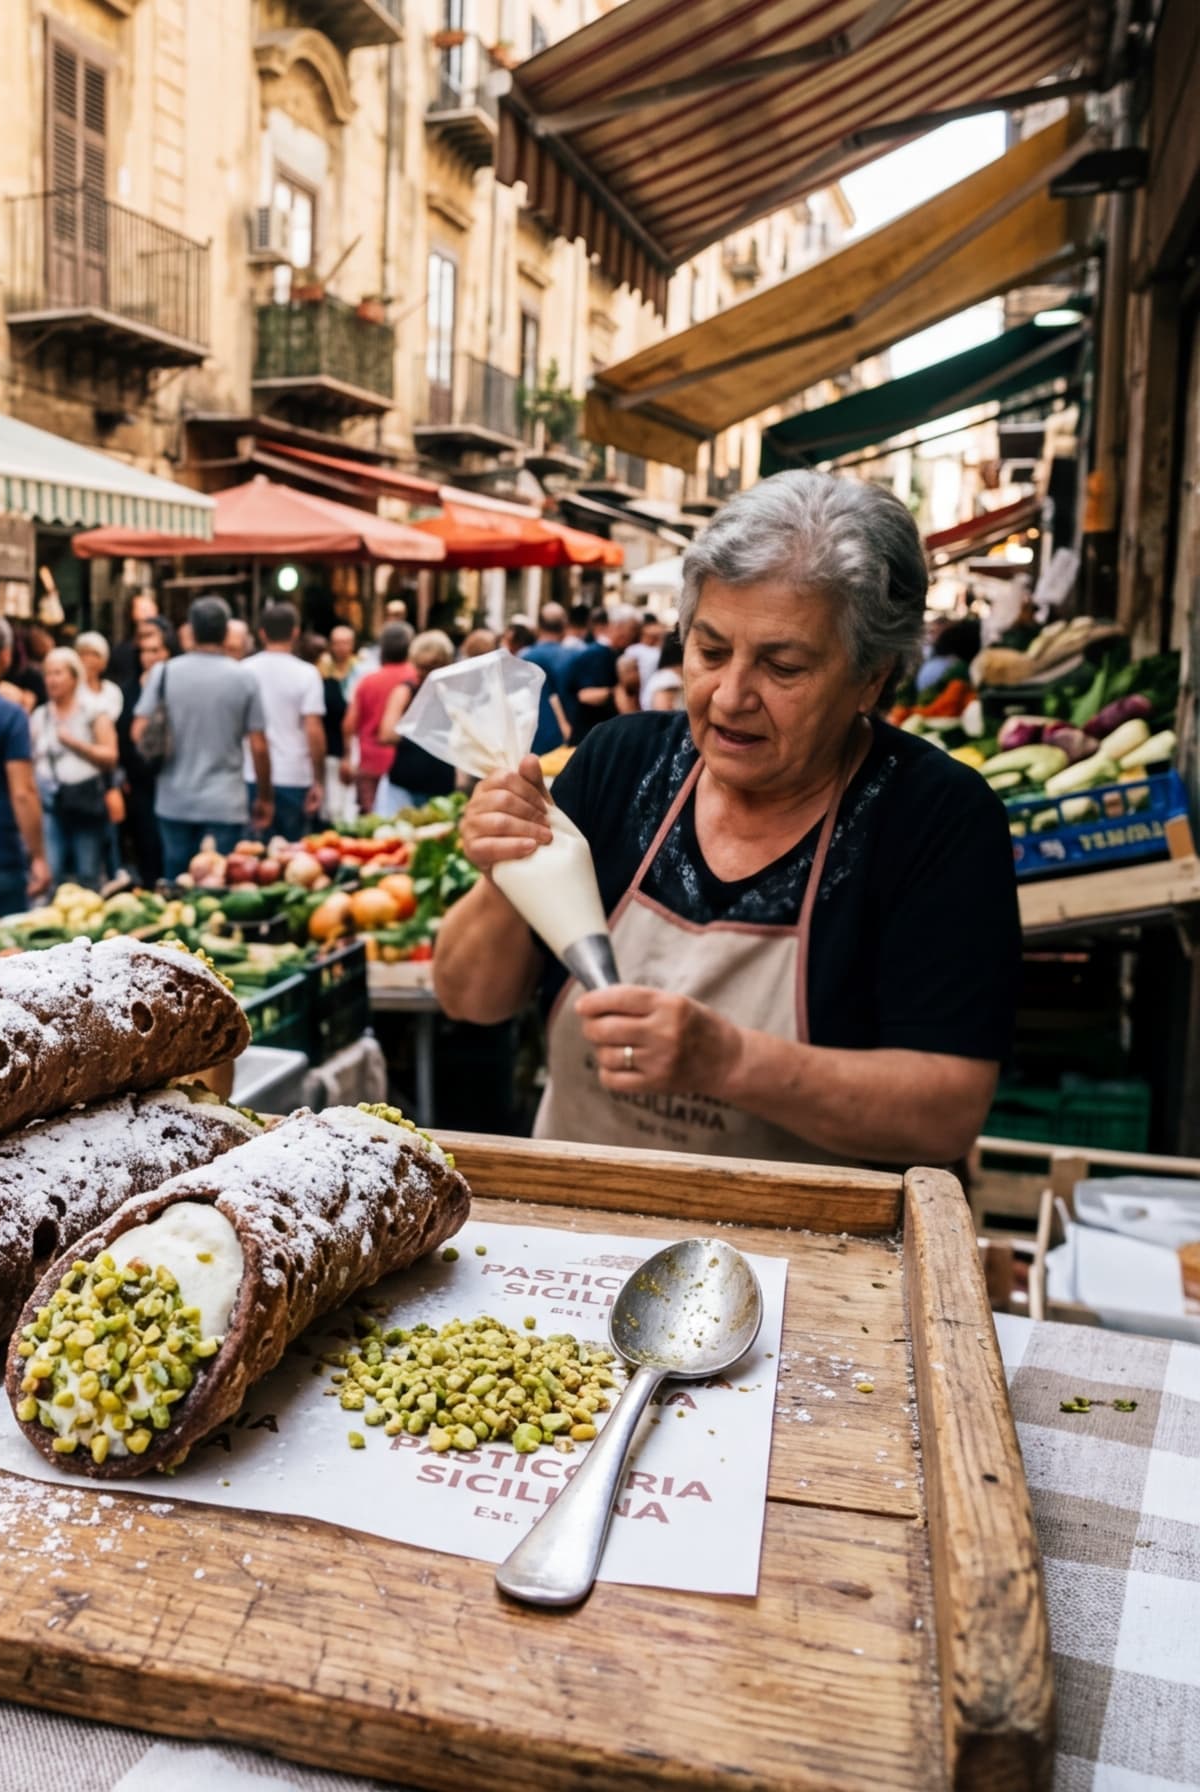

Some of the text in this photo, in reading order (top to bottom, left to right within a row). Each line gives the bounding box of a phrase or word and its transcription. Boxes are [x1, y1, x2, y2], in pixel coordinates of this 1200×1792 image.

[481, 1263, 624, 1290] PASTIC
[503, 1282, 615, 1307] SICILI
[389, 1434, 713, 1502] PSTICRIA
[416, 1464, 669, 1524] SICILINA
